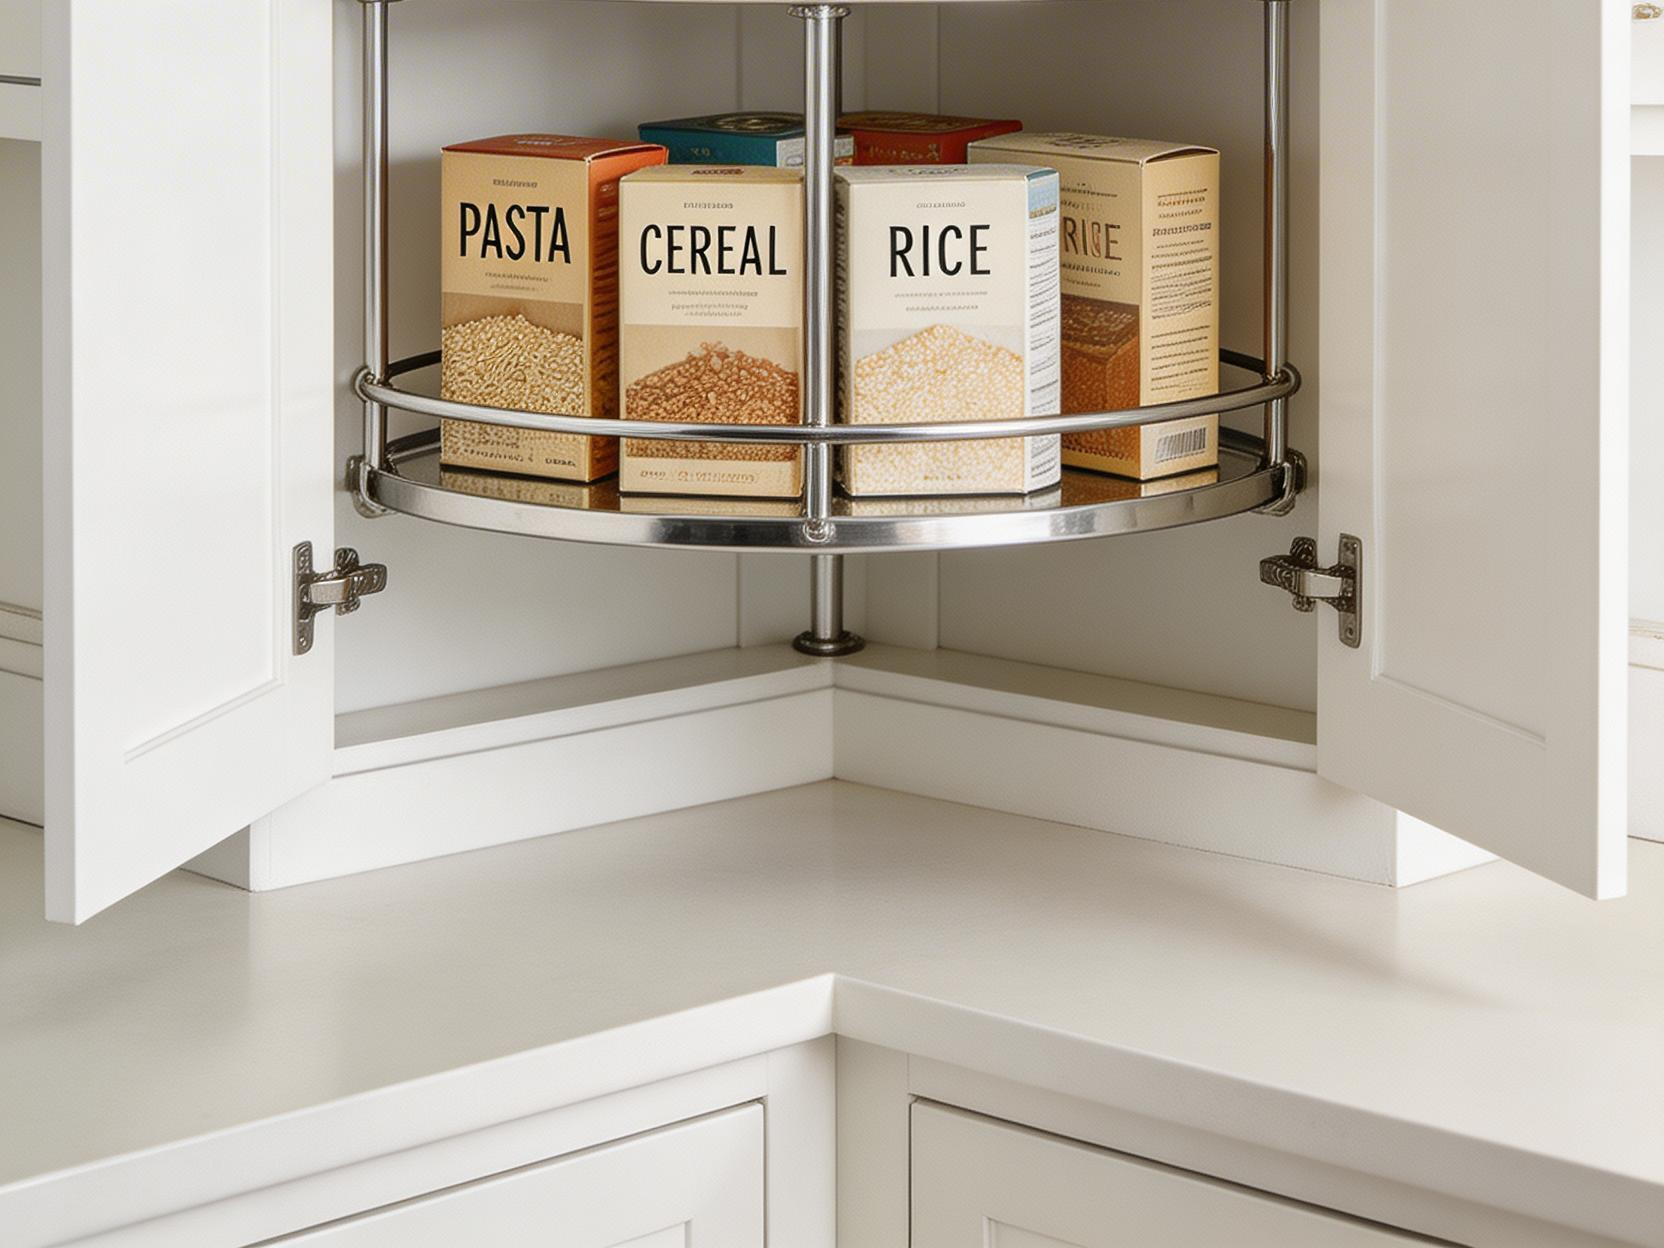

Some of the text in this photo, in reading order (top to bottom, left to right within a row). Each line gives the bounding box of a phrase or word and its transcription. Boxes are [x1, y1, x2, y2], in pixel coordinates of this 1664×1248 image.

[459, 201, 571, 264] PASTA
[639, 223, 787, 276] CEREAL
[889, 224, 991, 278] RICE
